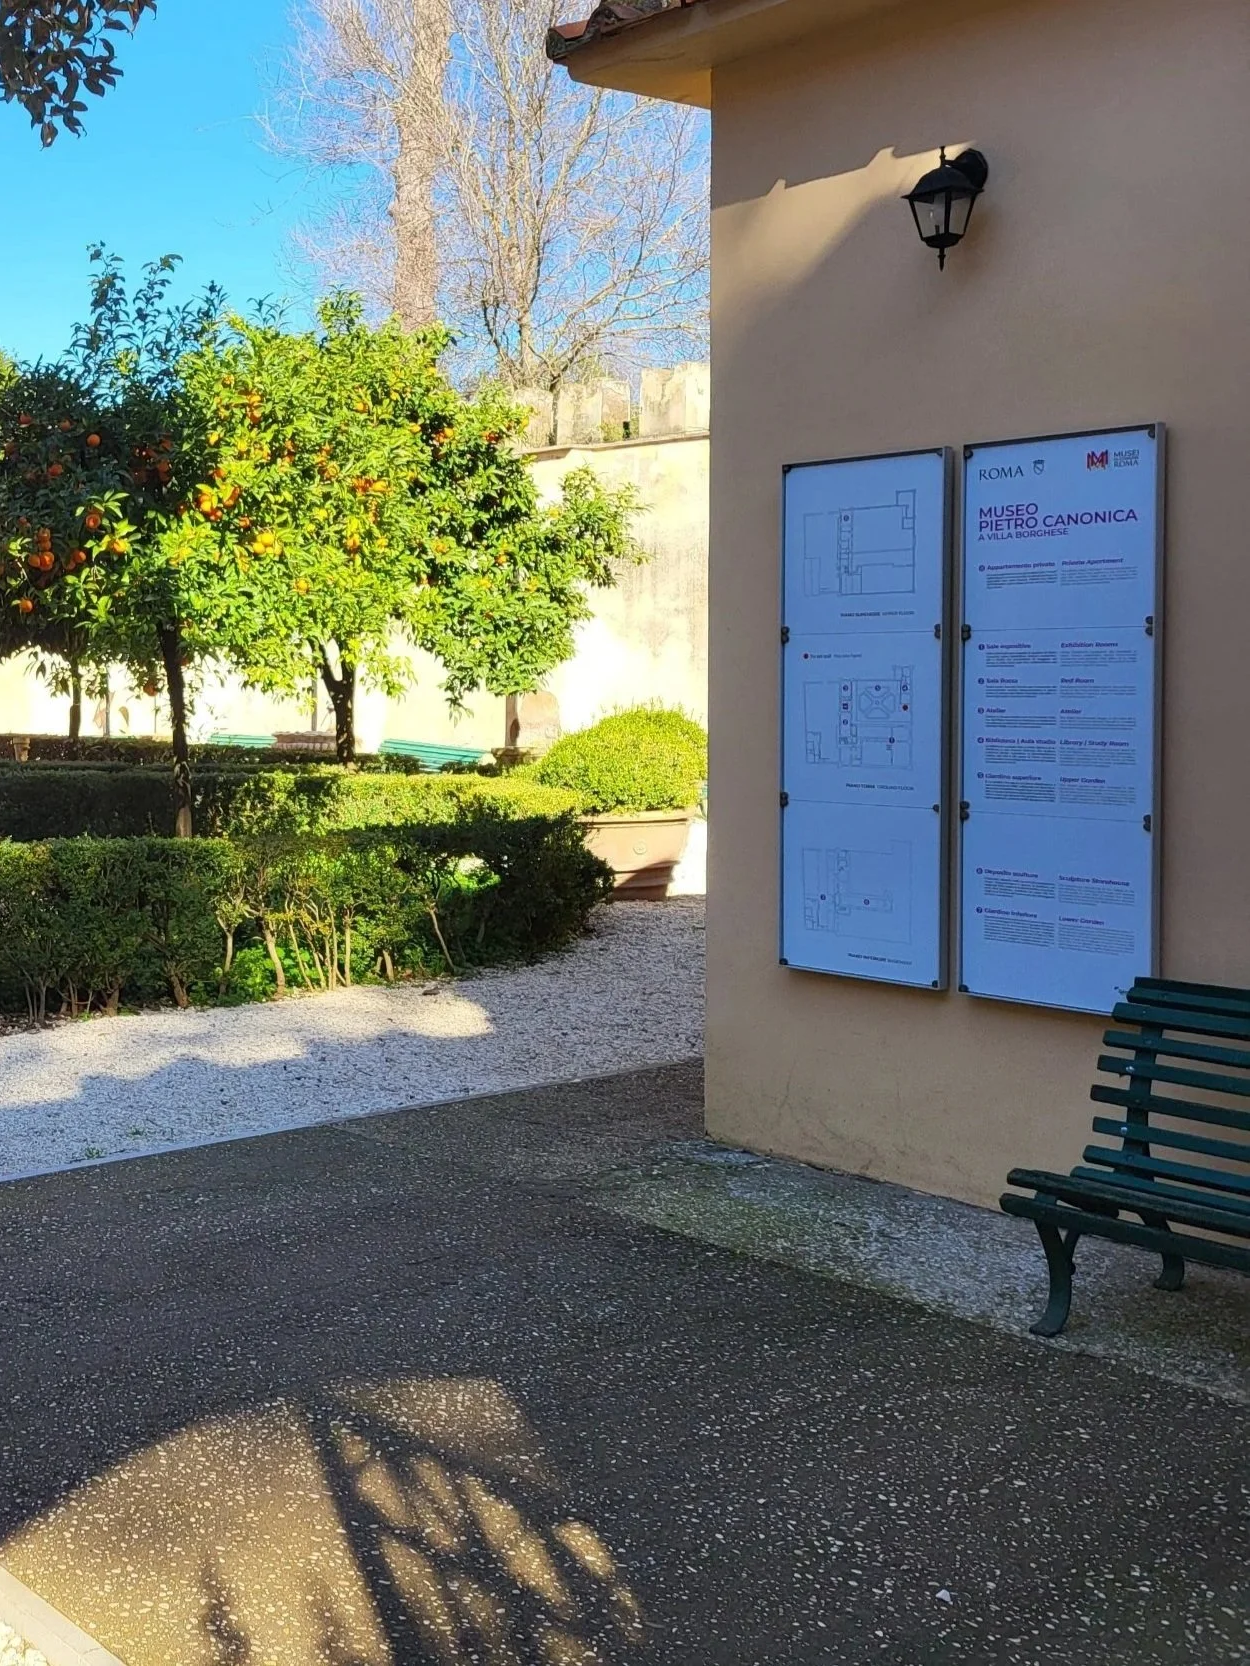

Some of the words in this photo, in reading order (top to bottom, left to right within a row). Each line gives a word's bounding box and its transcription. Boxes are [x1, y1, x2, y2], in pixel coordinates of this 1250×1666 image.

[1114, 449, 1140, 458] MUSEI
[1113, 459, 1139, 468] ROMA
[979, 465, 1024, 481] ROMA
[979, 502, 1038, 519] MUSEO
[979, 516, 1038, 532] PIETRO
[1042, 508, 1138, 528] CANONICA
[978, 533, 985, 541] A
[986, 530, 1014, 540] VILLA
[1016, 528, 1069, 539] BORGHESE
